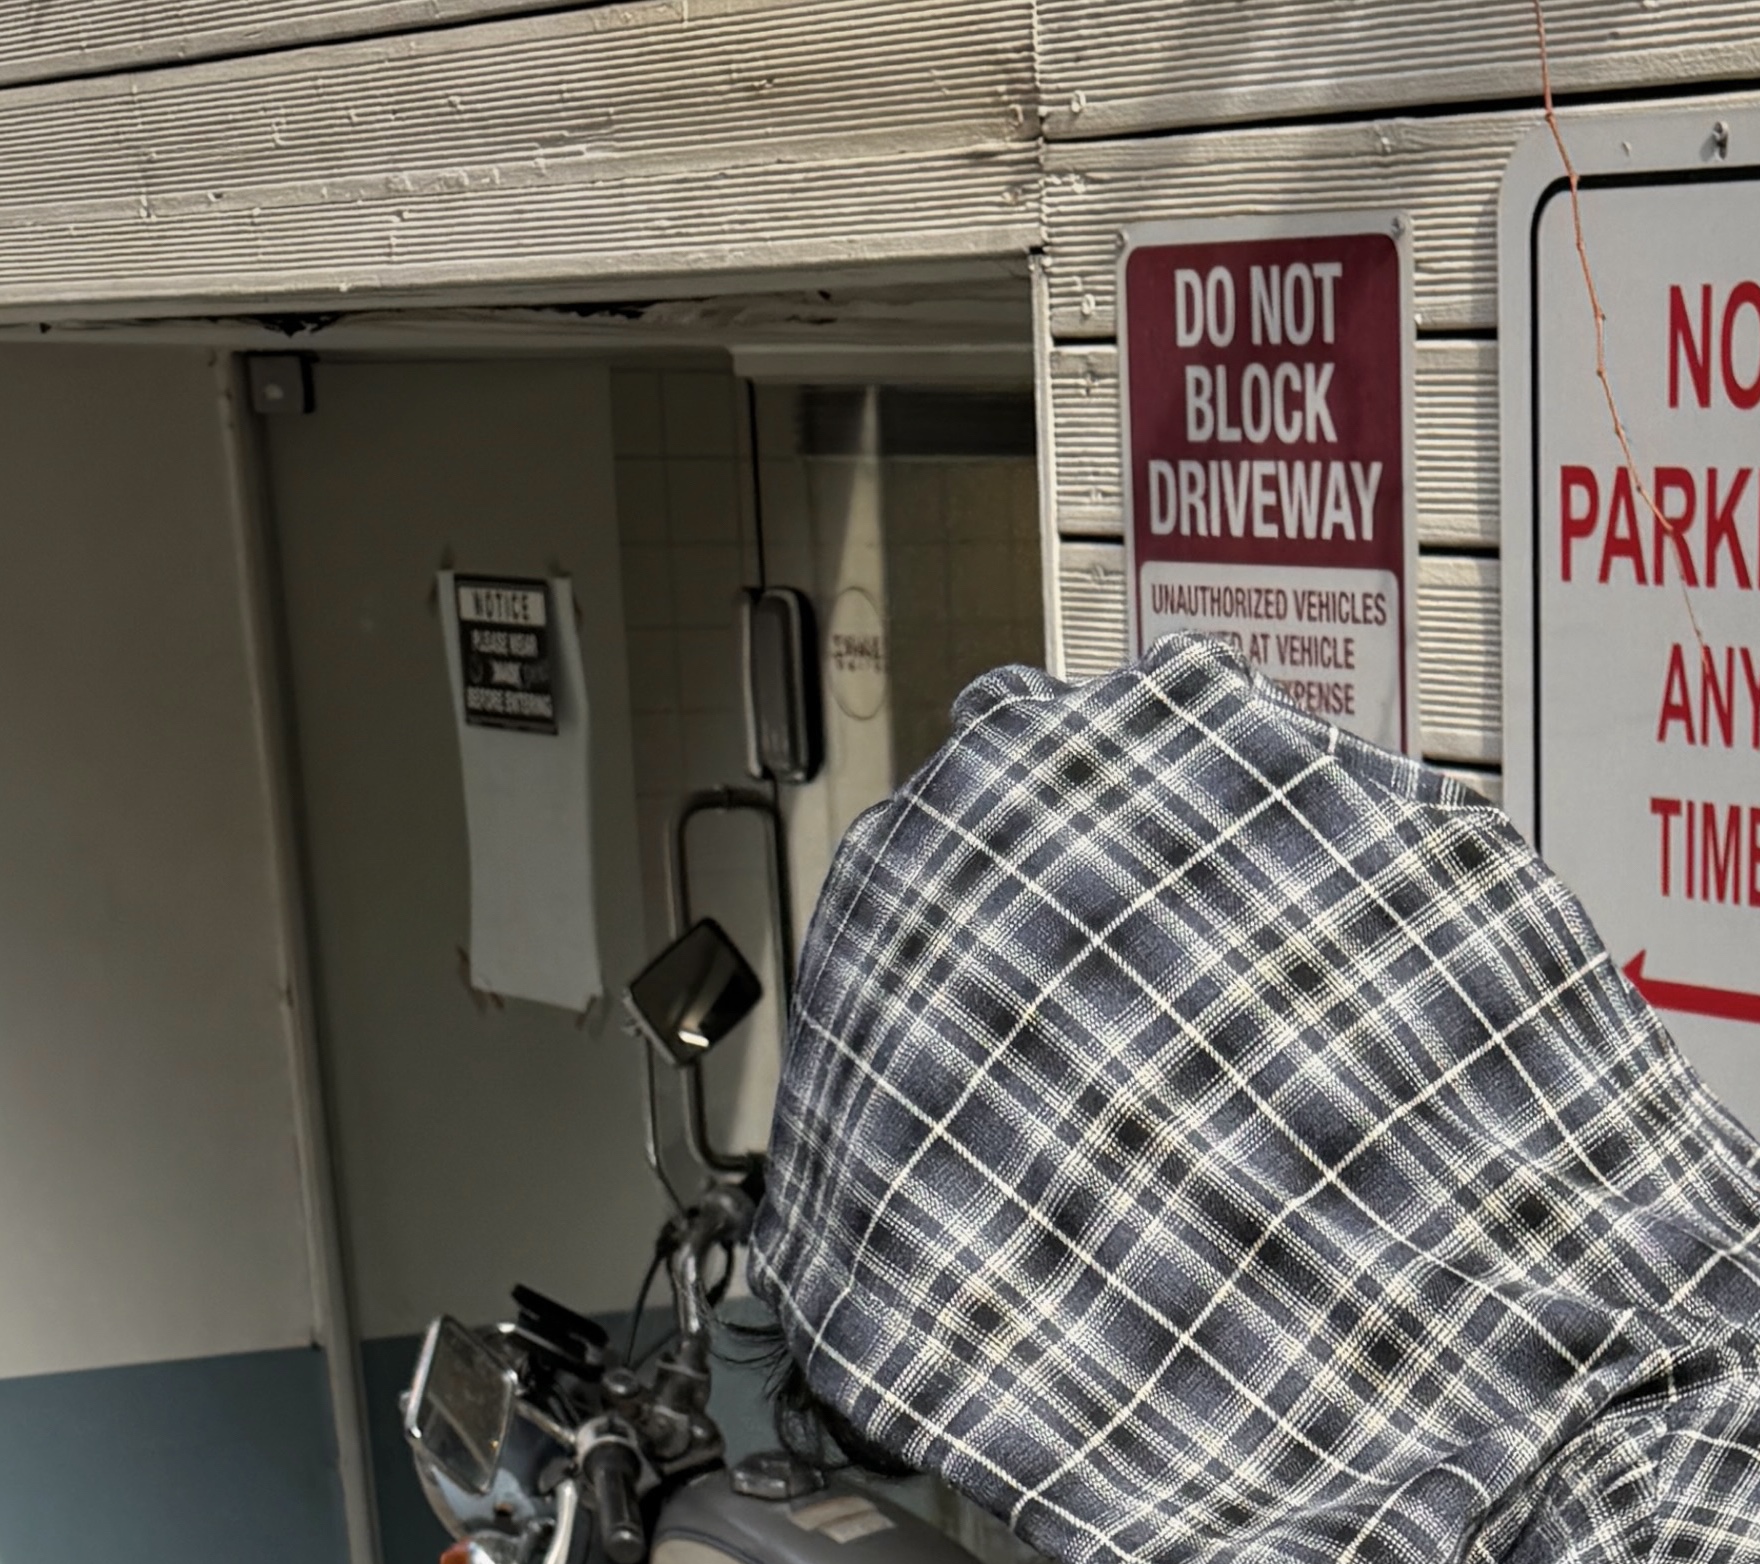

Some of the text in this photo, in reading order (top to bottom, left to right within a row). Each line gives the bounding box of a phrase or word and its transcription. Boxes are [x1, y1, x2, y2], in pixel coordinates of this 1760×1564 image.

[1174, 262, 1343, 349] DO NOT
[1185, 361, 1338, 444] BLOCK
[1148, 459, 1383, 541] DRIVEWAY
[472, 591, 530, 621] NOTICE
[1151, 583, 1387, 626] UNAUTHORIZED VEHICLES
[1249, 632, 1272, 665] AT
[1276, 634, 1355, 670] VEHICLE
